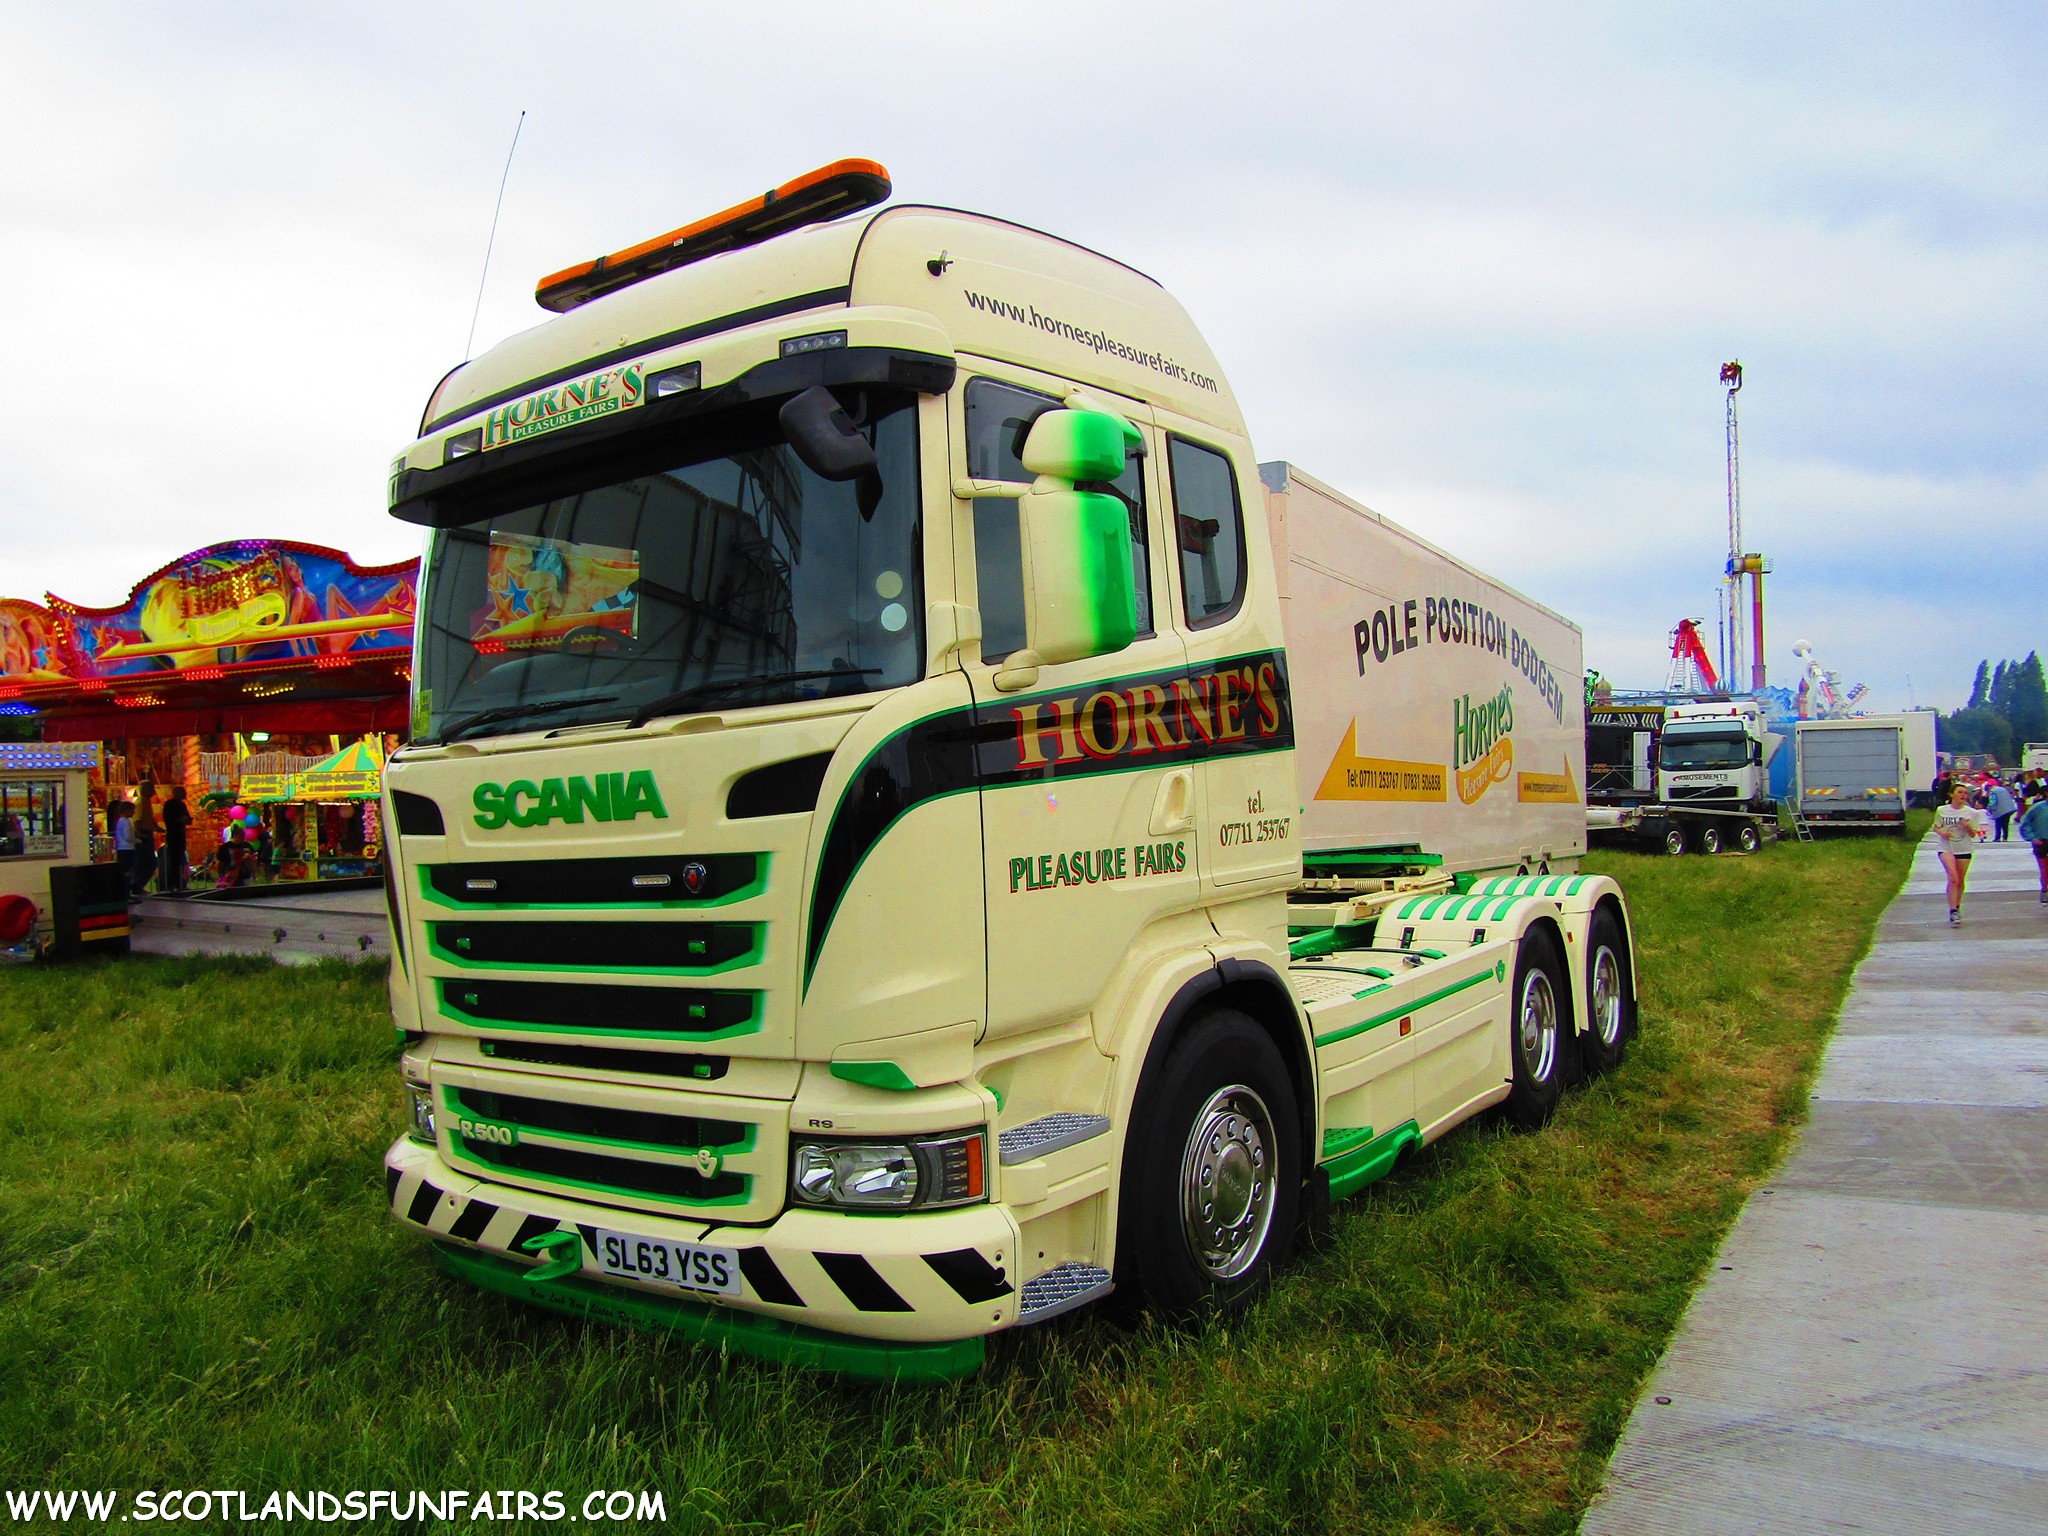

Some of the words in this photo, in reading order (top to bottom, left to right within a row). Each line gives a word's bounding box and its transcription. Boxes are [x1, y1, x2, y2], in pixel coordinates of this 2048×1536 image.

[963, 289, 1218, 394] www.hornespleasurefairs.com
[482, 361, 646, 450] HORNE'S
[515, 411, 575, 439] PLEASURE
[579, 399, 616, 419] FAIRS
[1353, 599, 1418, 678] POLE
[1425, 596, 1507, 660] POSITION
[1511, 626, 1564, 726] DODGEM
[1009, 660, 1280, 770] HORNE'S
[472, 769, 669, 830] SCANIA
[1219, 822, 1253, 847] 07711
[1256, 817, 1291, 842] 253767
[1008, 846, 1127, 893] PLEASURE
[1134, 840, 1187, 877] FAIRS
[808, 1118, 834, 1129] RS
[605, 1236, 669, 1277] SL63
[675, 1247, 729, 1287] YSS
